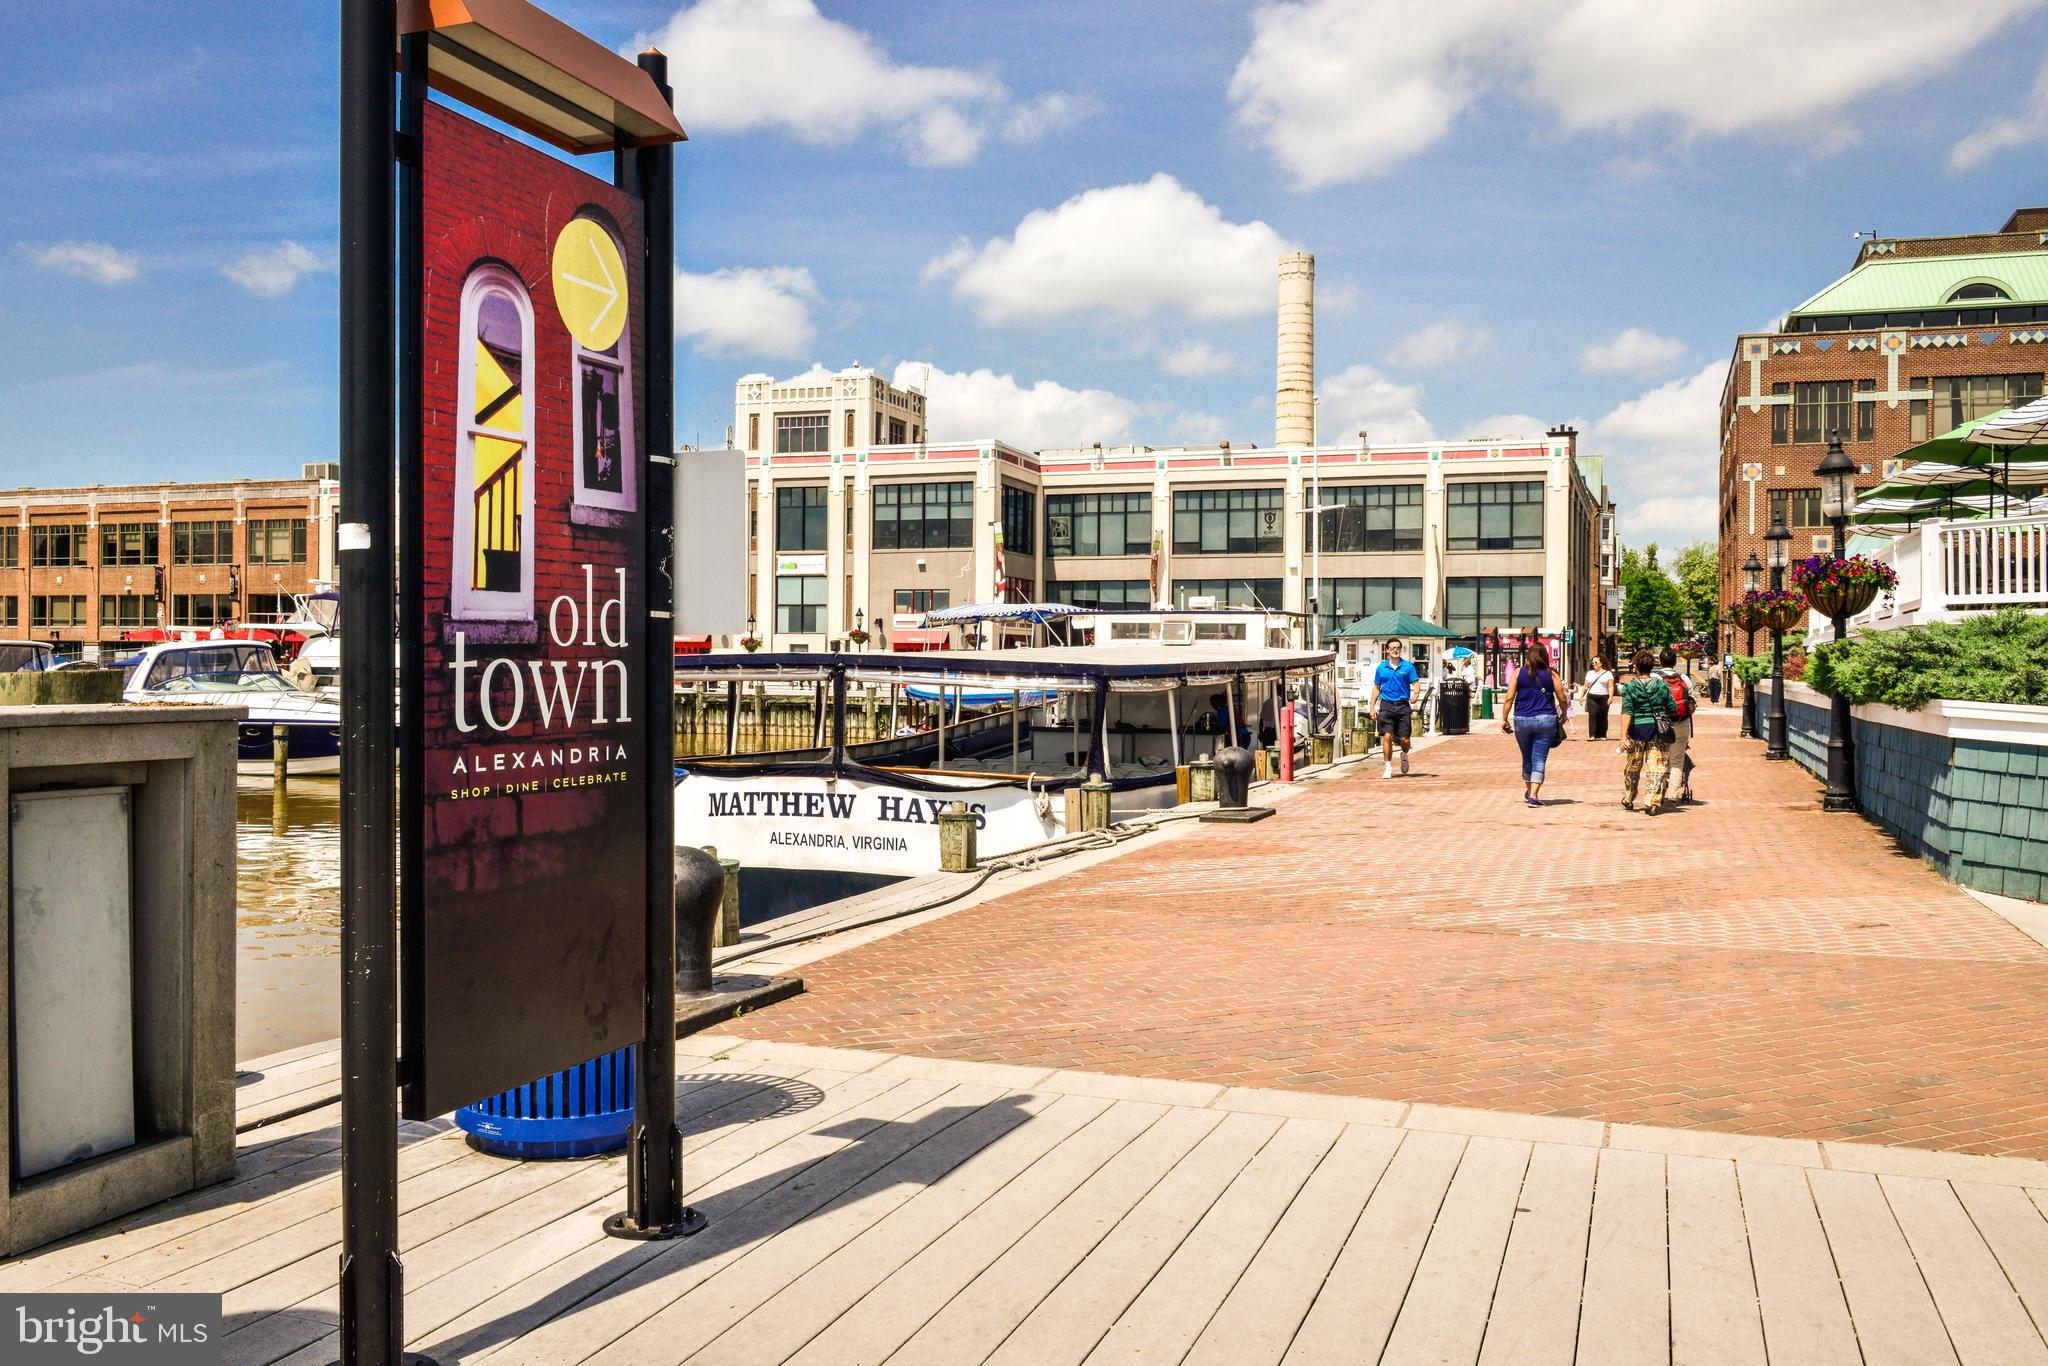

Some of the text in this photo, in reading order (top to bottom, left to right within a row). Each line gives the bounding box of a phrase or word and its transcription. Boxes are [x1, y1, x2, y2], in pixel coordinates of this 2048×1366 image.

[550, 564, 628, 647] old
[449, 632, 631, 732] town
[452, 744, 628, 775] ALEXANDRIA
[451, 771, 628, 799] SHOP DINE CELEBRATE
[708, 791, 987, 831] MATTHEW HAYS
[769, 831, 908, 852] ALEXANDRIA, VIRGINIA
